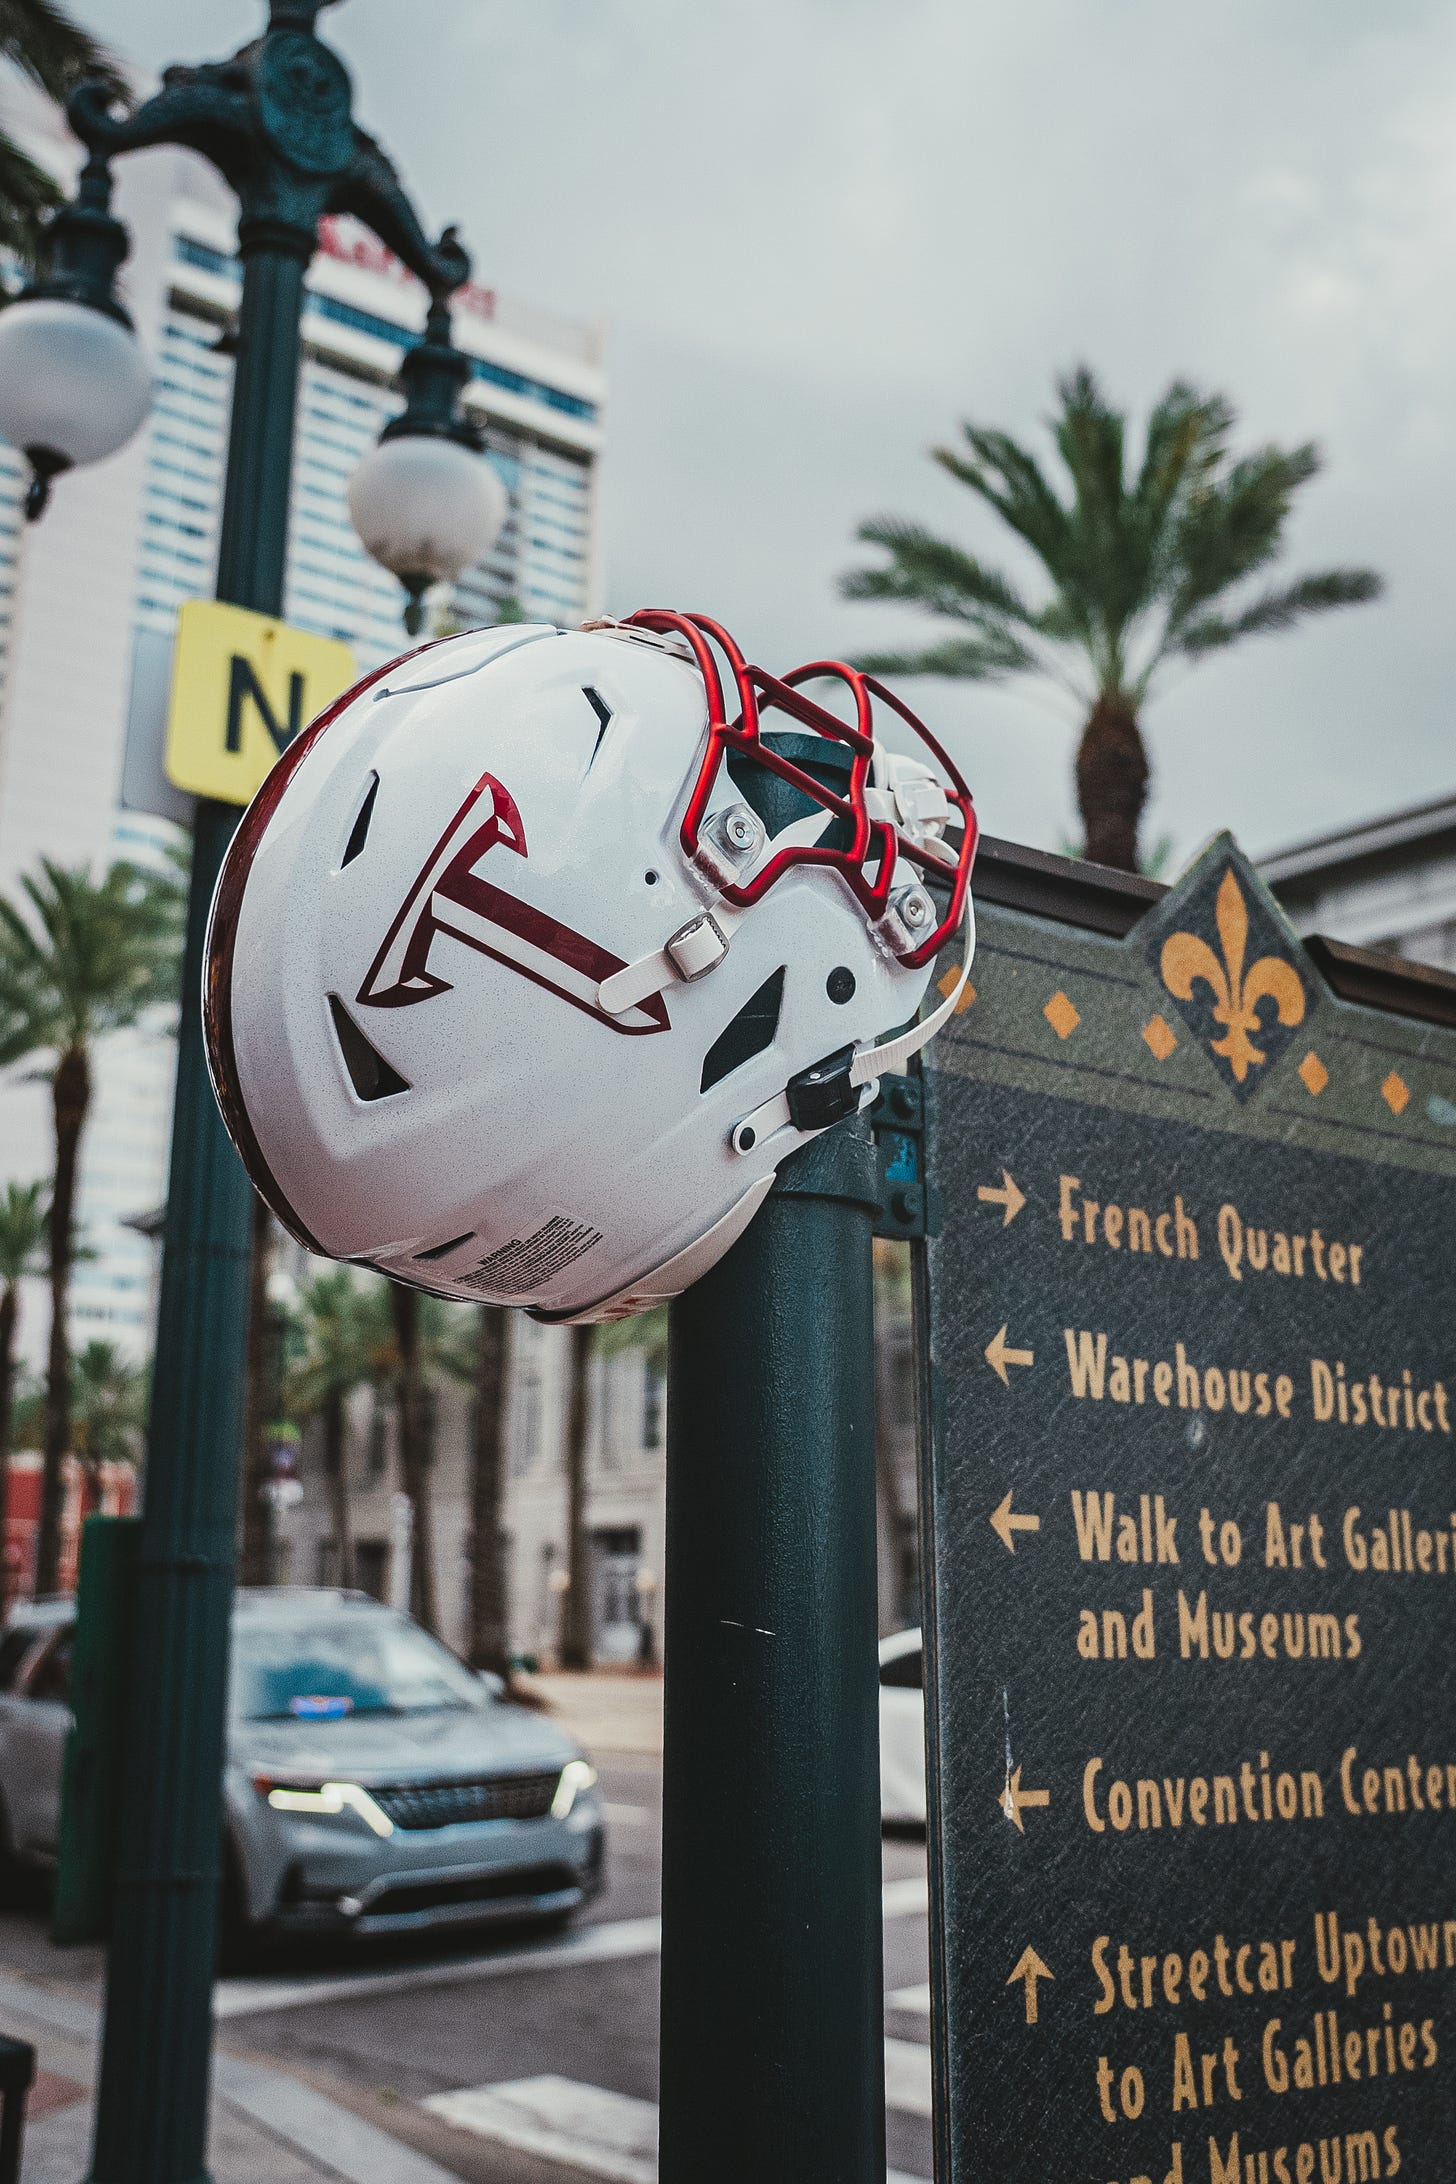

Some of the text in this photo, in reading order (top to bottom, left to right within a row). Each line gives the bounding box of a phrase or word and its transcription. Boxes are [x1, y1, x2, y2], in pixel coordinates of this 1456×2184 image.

[225, 655, 304, 755] N
[477, 1238, 523, 1266] WARNING
[1058, 1175, 1363, 1284] French Quarter
[1065, 1329, 1452, 1432] Warehouse District
[1071, 1490, 1180, 1564] Walk
[1199, 1509, 1242, 1566] to
[1265, 1502, 1326, 1569] Art
[1077, 1588, 1361, 1659] and Museums
[1083, 1747, 1456, 1833] Convention Center
[1091, 1911, 1456, 2015] Streetcar Uptown
[1096, 2002, 1438, 2123] to Art Galleries
[1208, 2126, 1402, 2184] Museums
